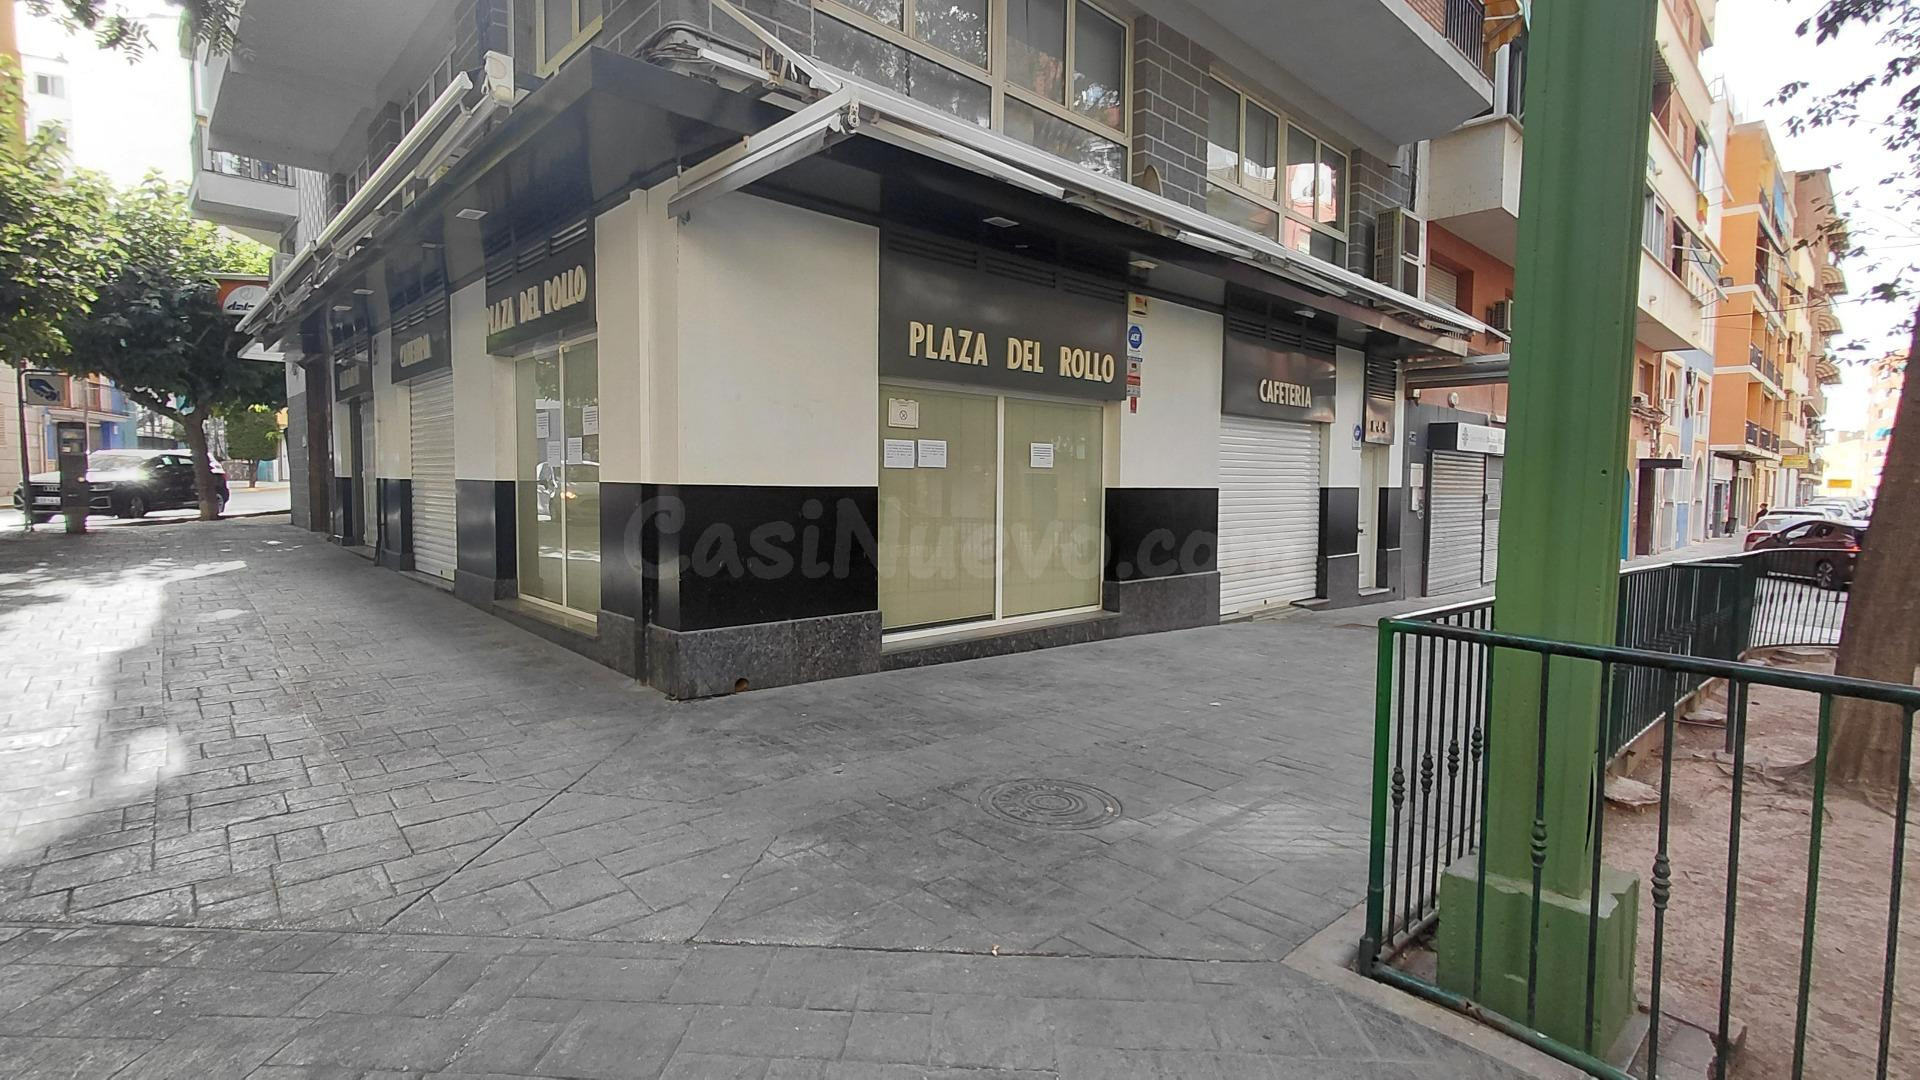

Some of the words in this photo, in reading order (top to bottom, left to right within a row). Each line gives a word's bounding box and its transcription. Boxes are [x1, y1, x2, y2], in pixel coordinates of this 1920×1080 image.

[520, 285, 541, 324] DEL
[543, 264, 587, 315] ROLLO
[909, 320, 988, 367] PLAZA
[1007, 337, 1043, 374] DEL
[1058, 346, 1114, 383] ROLLO
[1259, 379, 1312, 408] CAFETERIA
